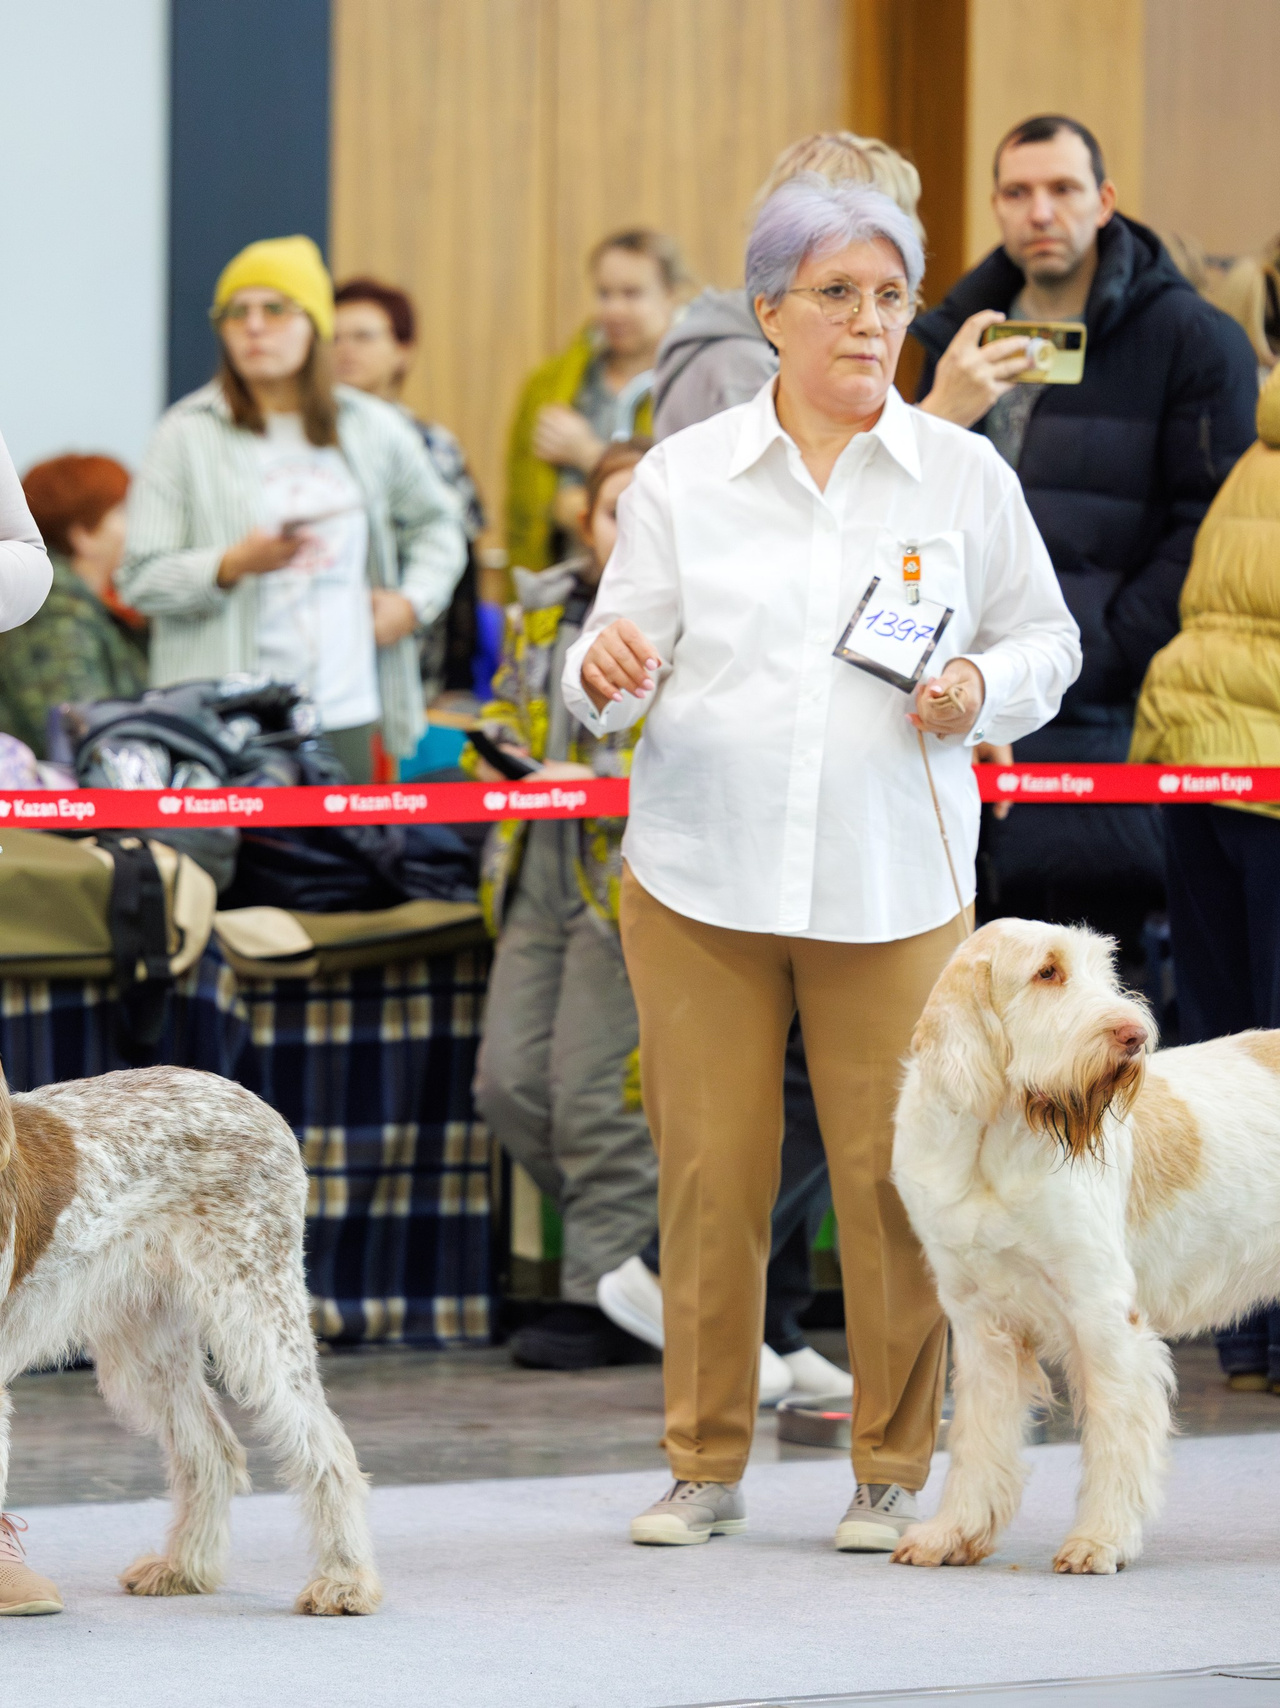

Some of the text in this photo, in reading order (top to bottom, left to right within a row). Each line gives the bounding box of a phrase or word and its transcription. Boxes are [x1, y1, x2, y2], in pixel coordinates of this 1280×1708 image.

[865, 610, 935, 643] 1397
[13, 798, 95, 820] Kazan Expo
[184, 794, 264, 816] Kazan Expo
[349, 792, 428, 814] Kazan Expo
[509, 788, 587, 810] Kazan Expo
